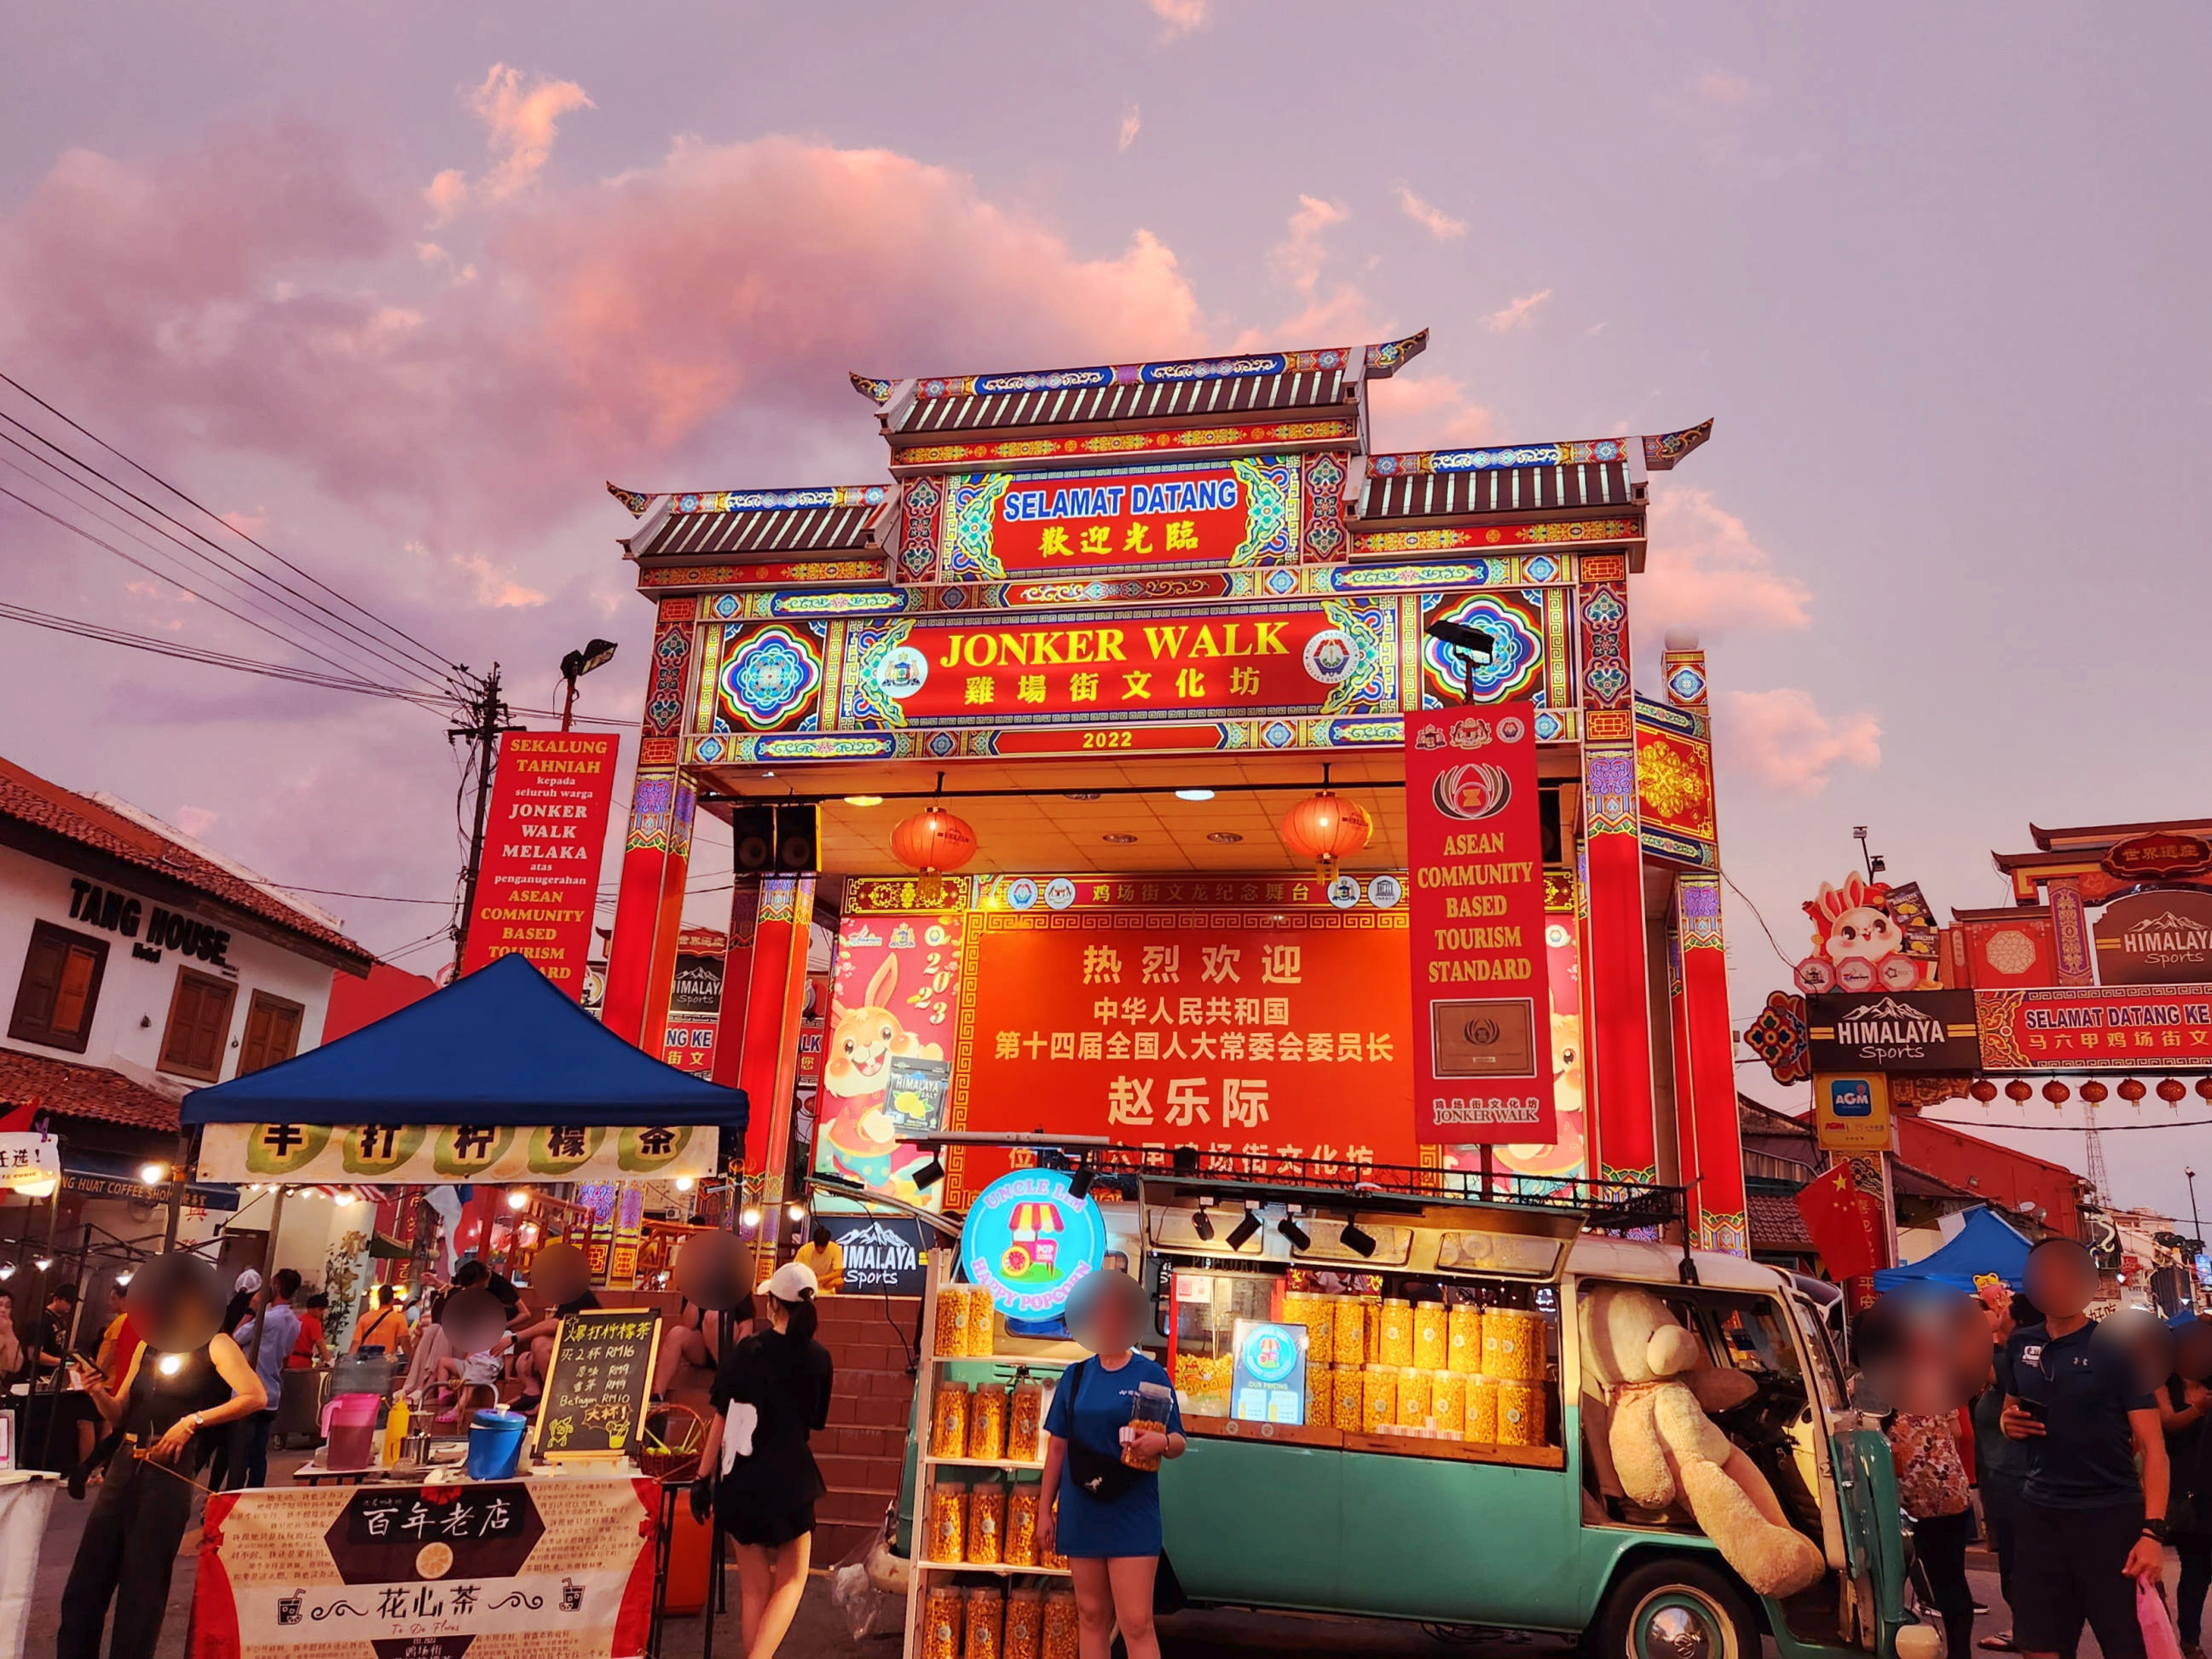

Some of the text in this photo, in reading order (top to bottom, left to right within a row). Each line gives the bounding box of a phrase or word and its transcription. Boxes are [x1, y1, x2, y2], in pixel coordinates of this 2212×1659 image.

[1004, 480, 1237, 521] SELAMAT DATANG
[1037, 522, 1199, 558] 歡迎光臨
[940, 621, 1290, 668] JONKER WALK
[964, 667, 1261, 705] 雞場街文化坊
[510, 738, 607, 754] SEKALUNG
[1083, 731, 1132, 749] 2022
[517, 759, 601, 773] TAHNIAH
[536, 776, 576, 786] kepada
[515, 789, 593, 799] seluruh warga
[508, 803, 587, 819] JONKER
[521, 824, 577, 838] WALK
[501, 844, 587, 859] MELAKA
[1443, 832, 1505, 856] ASEAN
[529, 862, 552, 871] atas
[1417, 862, 1533, 888] COMMUNITY
[494, 875, 586, 885] penganugerahan
[508, 890, 563, 903] ASEAN
[1446, 894, 1507, 918] BASED
[69, 877, 231, 966] TANG HOUSE
[480, 908, 584, 922] COMMUNITY
[502, 927, 557, 940] BASED
[1435, 926, 1522, 951] TOURISM
[2124, 929, 2212, 953] HIMALAY
[1083, 944, 1302, 986] 热烈欢迎
[2145, 951, 2204, 968] Sports
[1428, 957, 1532, 983] STANDARD
[677, 995, 714, 1006] Sports
[1093, 997, 1290, 1027] 中华人民共和国
[2025, 1004, 2210, 1029] SELAMAT DATANG KE
[690, 1029, 713, 1048] KE
[1838, 1020, 1945, 1044] HIMALAYA
[800, 1034, 823, 1053] LK
[995, 1031, 1394, 1063] 第十四届全国人大常委会委员长
[1858, 1044, 1926, 1064] Sports
[896, 1078, 939, 1093] HIMALAYA
[1108, 1076, 1270, 1128] 赵乐际
[1835, 1092, 1868, 1105] AGM
[1434, 1109, 1539, 1124] JONKER WALK
[78, 1180, 104, 1194] HUAT
[107, 1182, 143, 1199] COFFEE
[984, 1178, 1051, 1211] UNCLE
[842, 1246, 917, 1270] IMALAYA
[1036, 1245, 1054, 1254] POP
[843, 1269, 898, 1289] Sports
[971, 1257, 1019, 1307] HAPPY
[605, 1344, 635, 1359] RM16
[1248, 1380, 1288, 1391] OUR PRICING
[601, 1393, 631, 1404] RM10
[363, 1498, 511, 1539] 百年老店
[376, 1585, 482, 1620] 花心茶
